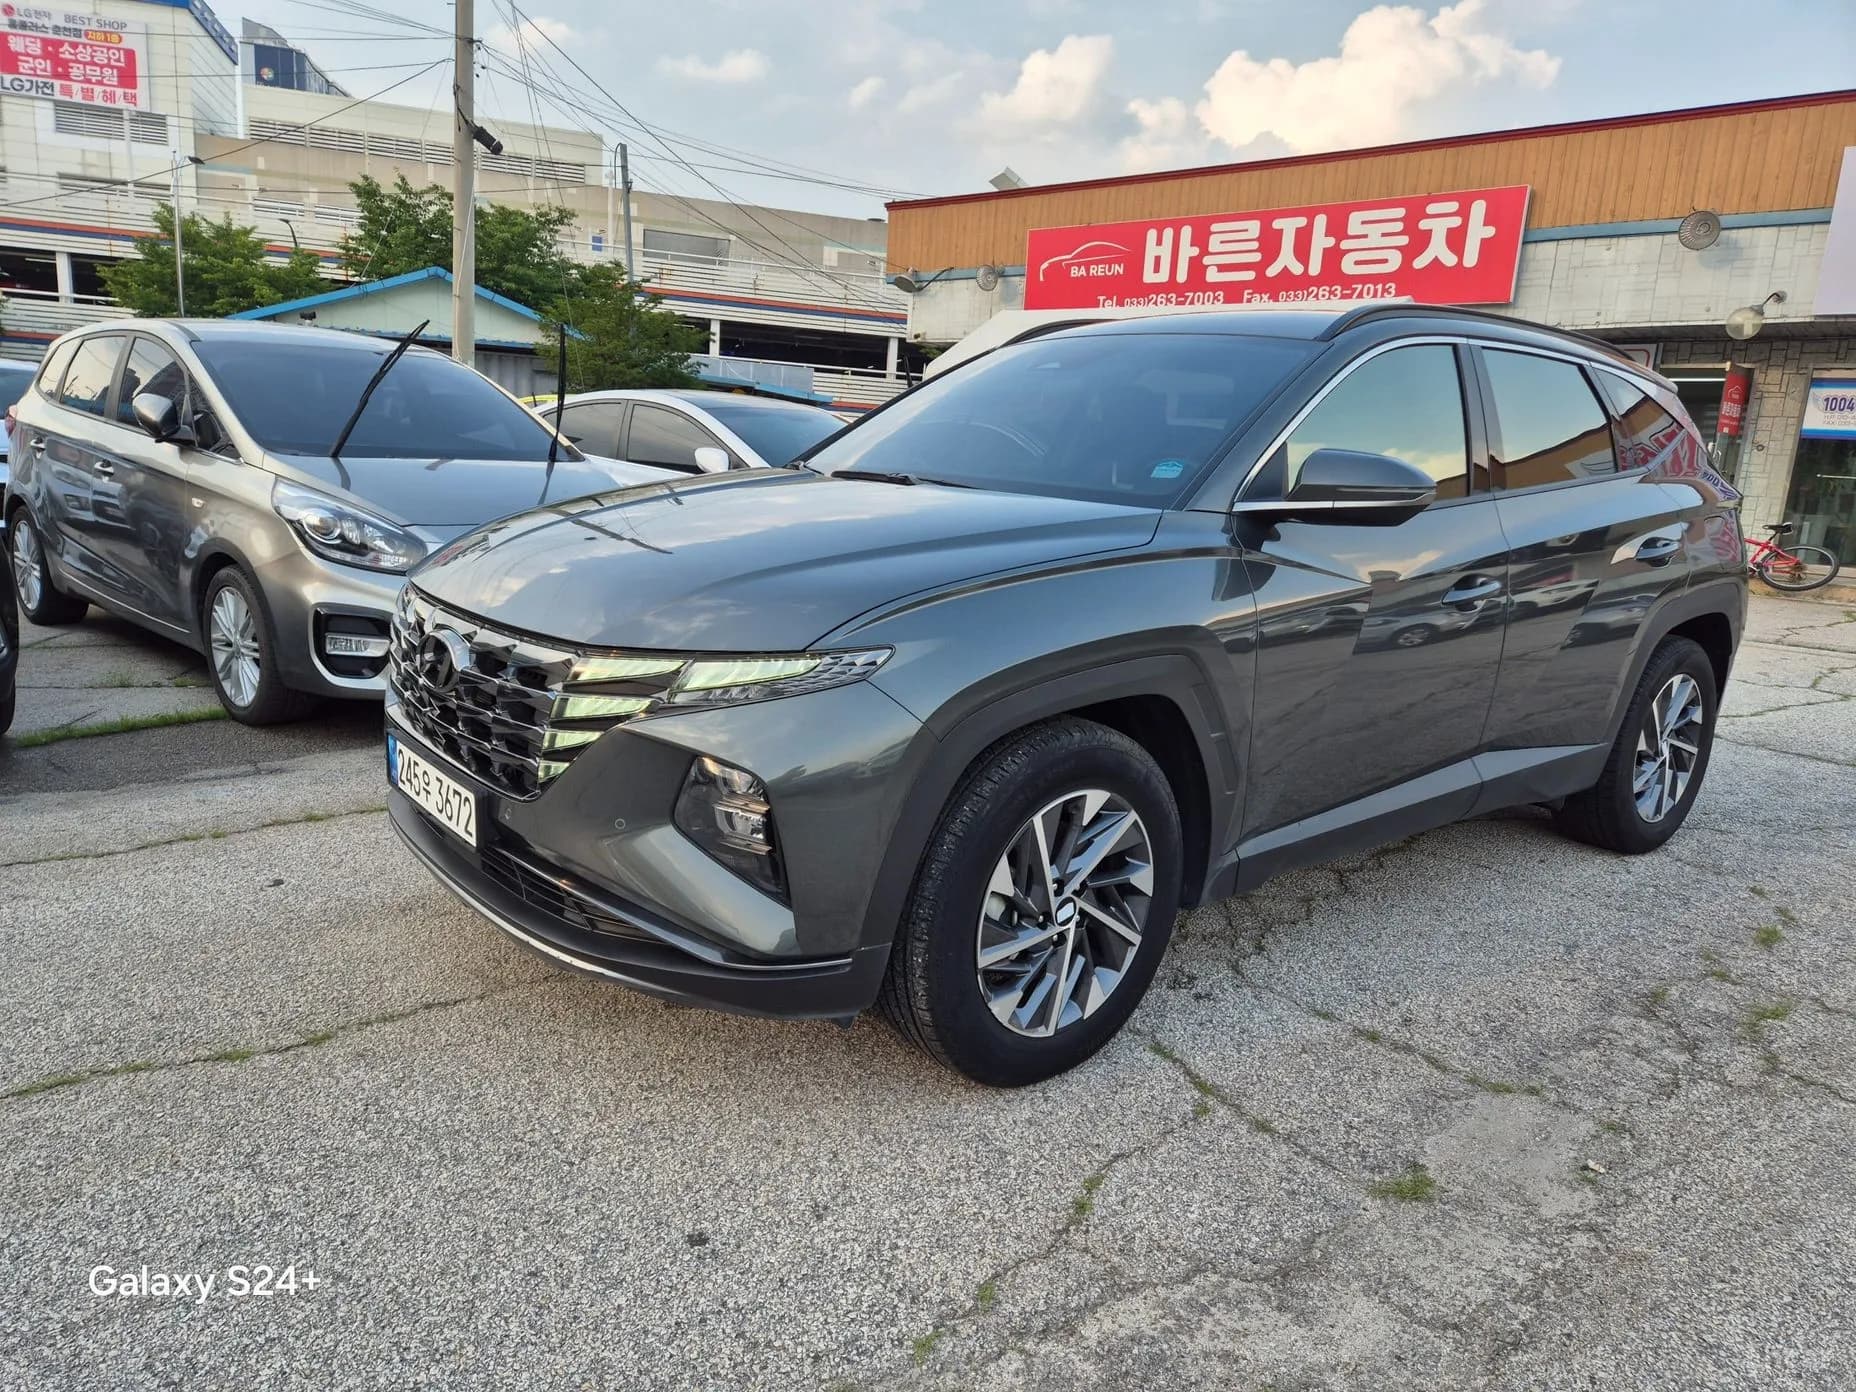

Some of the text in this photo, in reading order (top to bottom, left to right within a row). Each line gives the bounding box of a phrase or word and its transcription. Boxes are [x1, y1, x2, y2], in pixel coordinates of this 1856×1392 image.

[64, 14, 93, 27] BEST
[96, 18, 128, 31] SHOP
[7, 34, 42, 55] 웨딩
[59, 42, 125, 66] 소상공인
[18, 55, 51, 75] 군인
[68, 62, 118, 85] 공무원
[0, 76, 55, 97] LG가전
[1142, 199, 1497, 284] 바른자동차
[1070, 263, 1125, 278] BA REUN
[398, 748, 474, 838] 245우 3672
